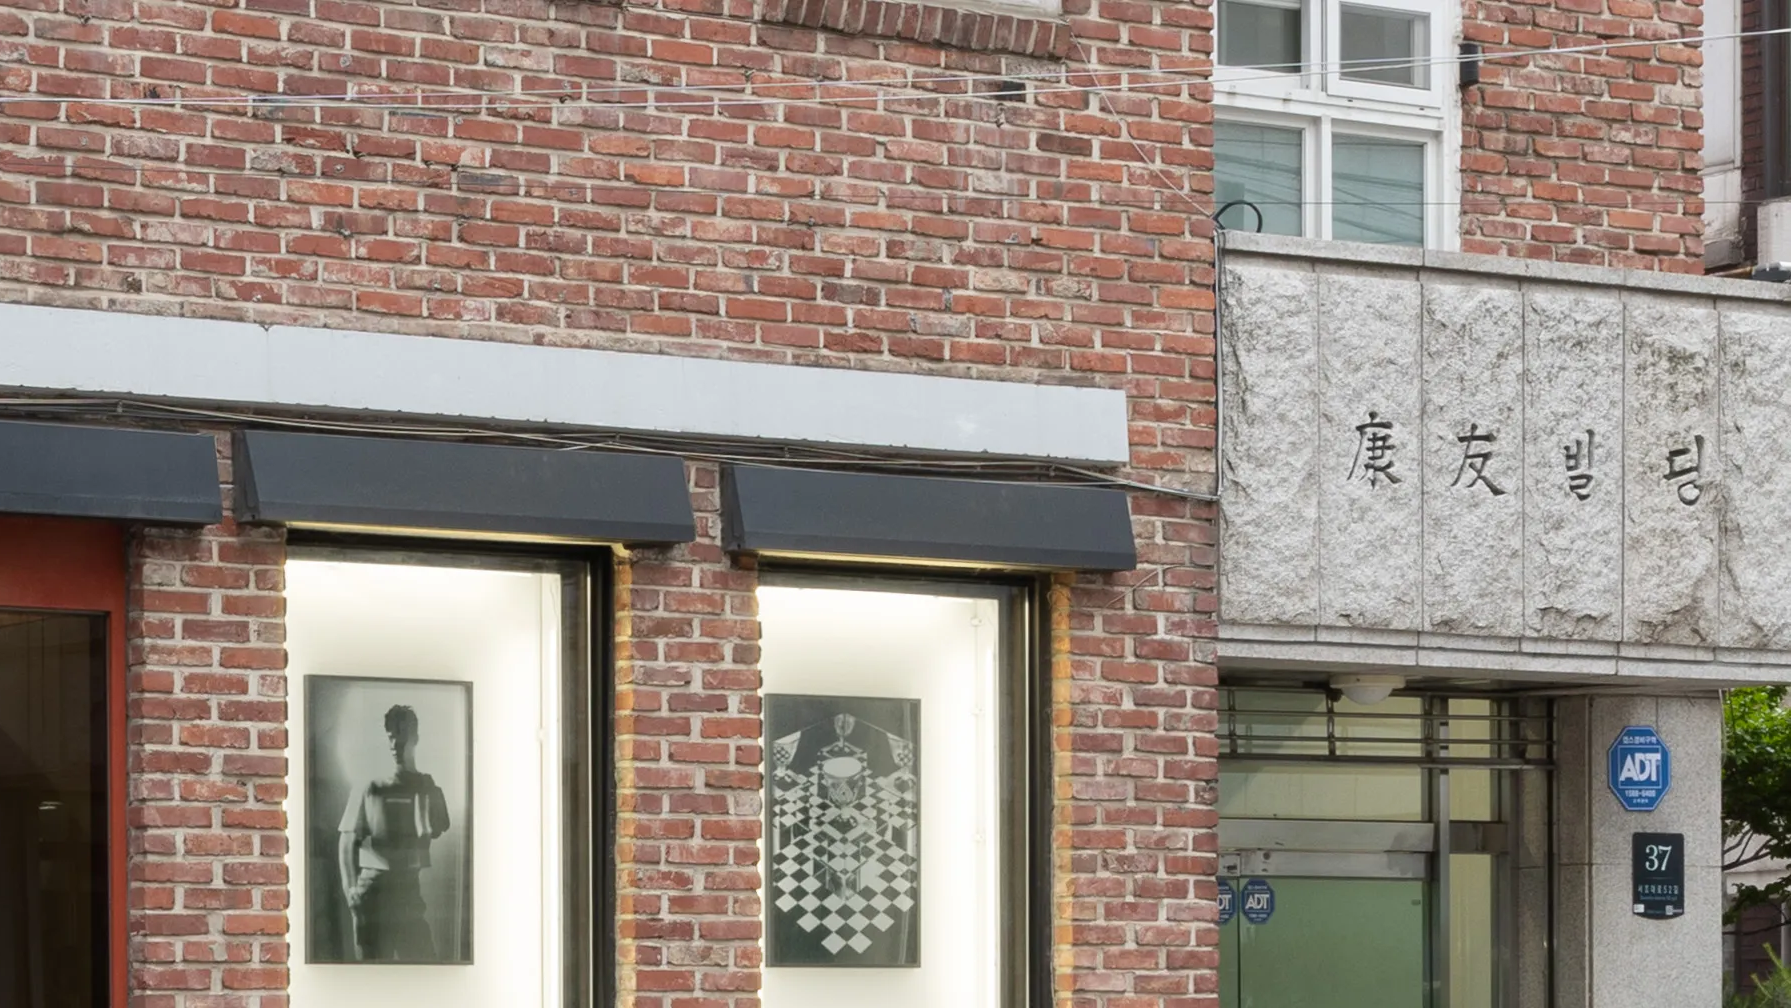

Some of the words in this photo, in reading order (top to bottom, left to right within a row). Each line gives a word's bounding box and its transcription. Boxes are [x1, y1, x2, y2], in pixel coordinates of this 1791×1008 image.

[1620, 752, 1661, 782] ADT
[1645, 844, 1672, 871] 37
[1217, 893, 1232, 910] DT
[1245, 893, 1270, 910] ADT
